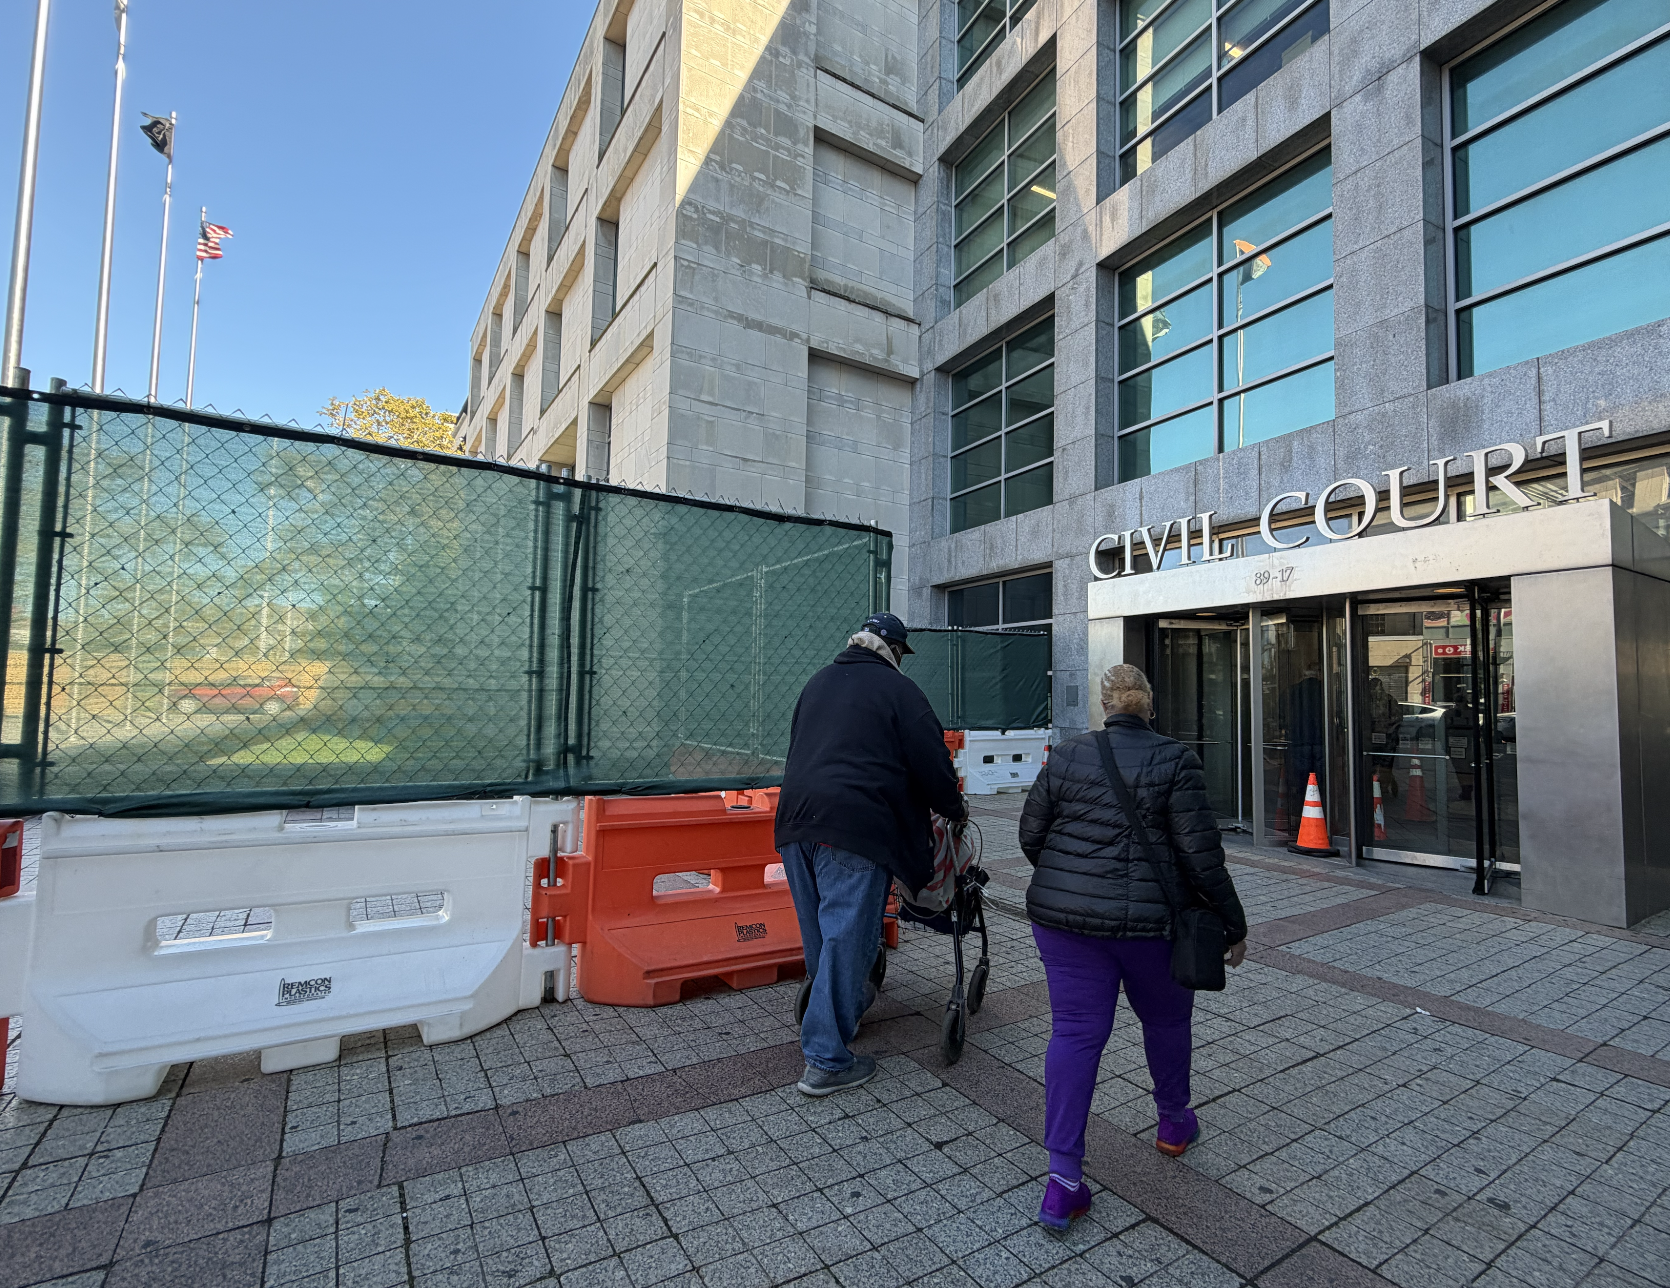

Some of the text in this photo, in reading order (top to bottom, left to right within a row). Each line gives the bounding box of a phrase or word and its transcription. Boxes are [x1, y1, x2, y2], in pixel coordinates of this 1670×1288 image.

[1088, 419, 1613, 579] CIVIL COURT
[1254, 566, 1294, 586] 89-17
[282, 977, 332, 990] REMCON
[282, 984, 332, 997] PLASTICS
